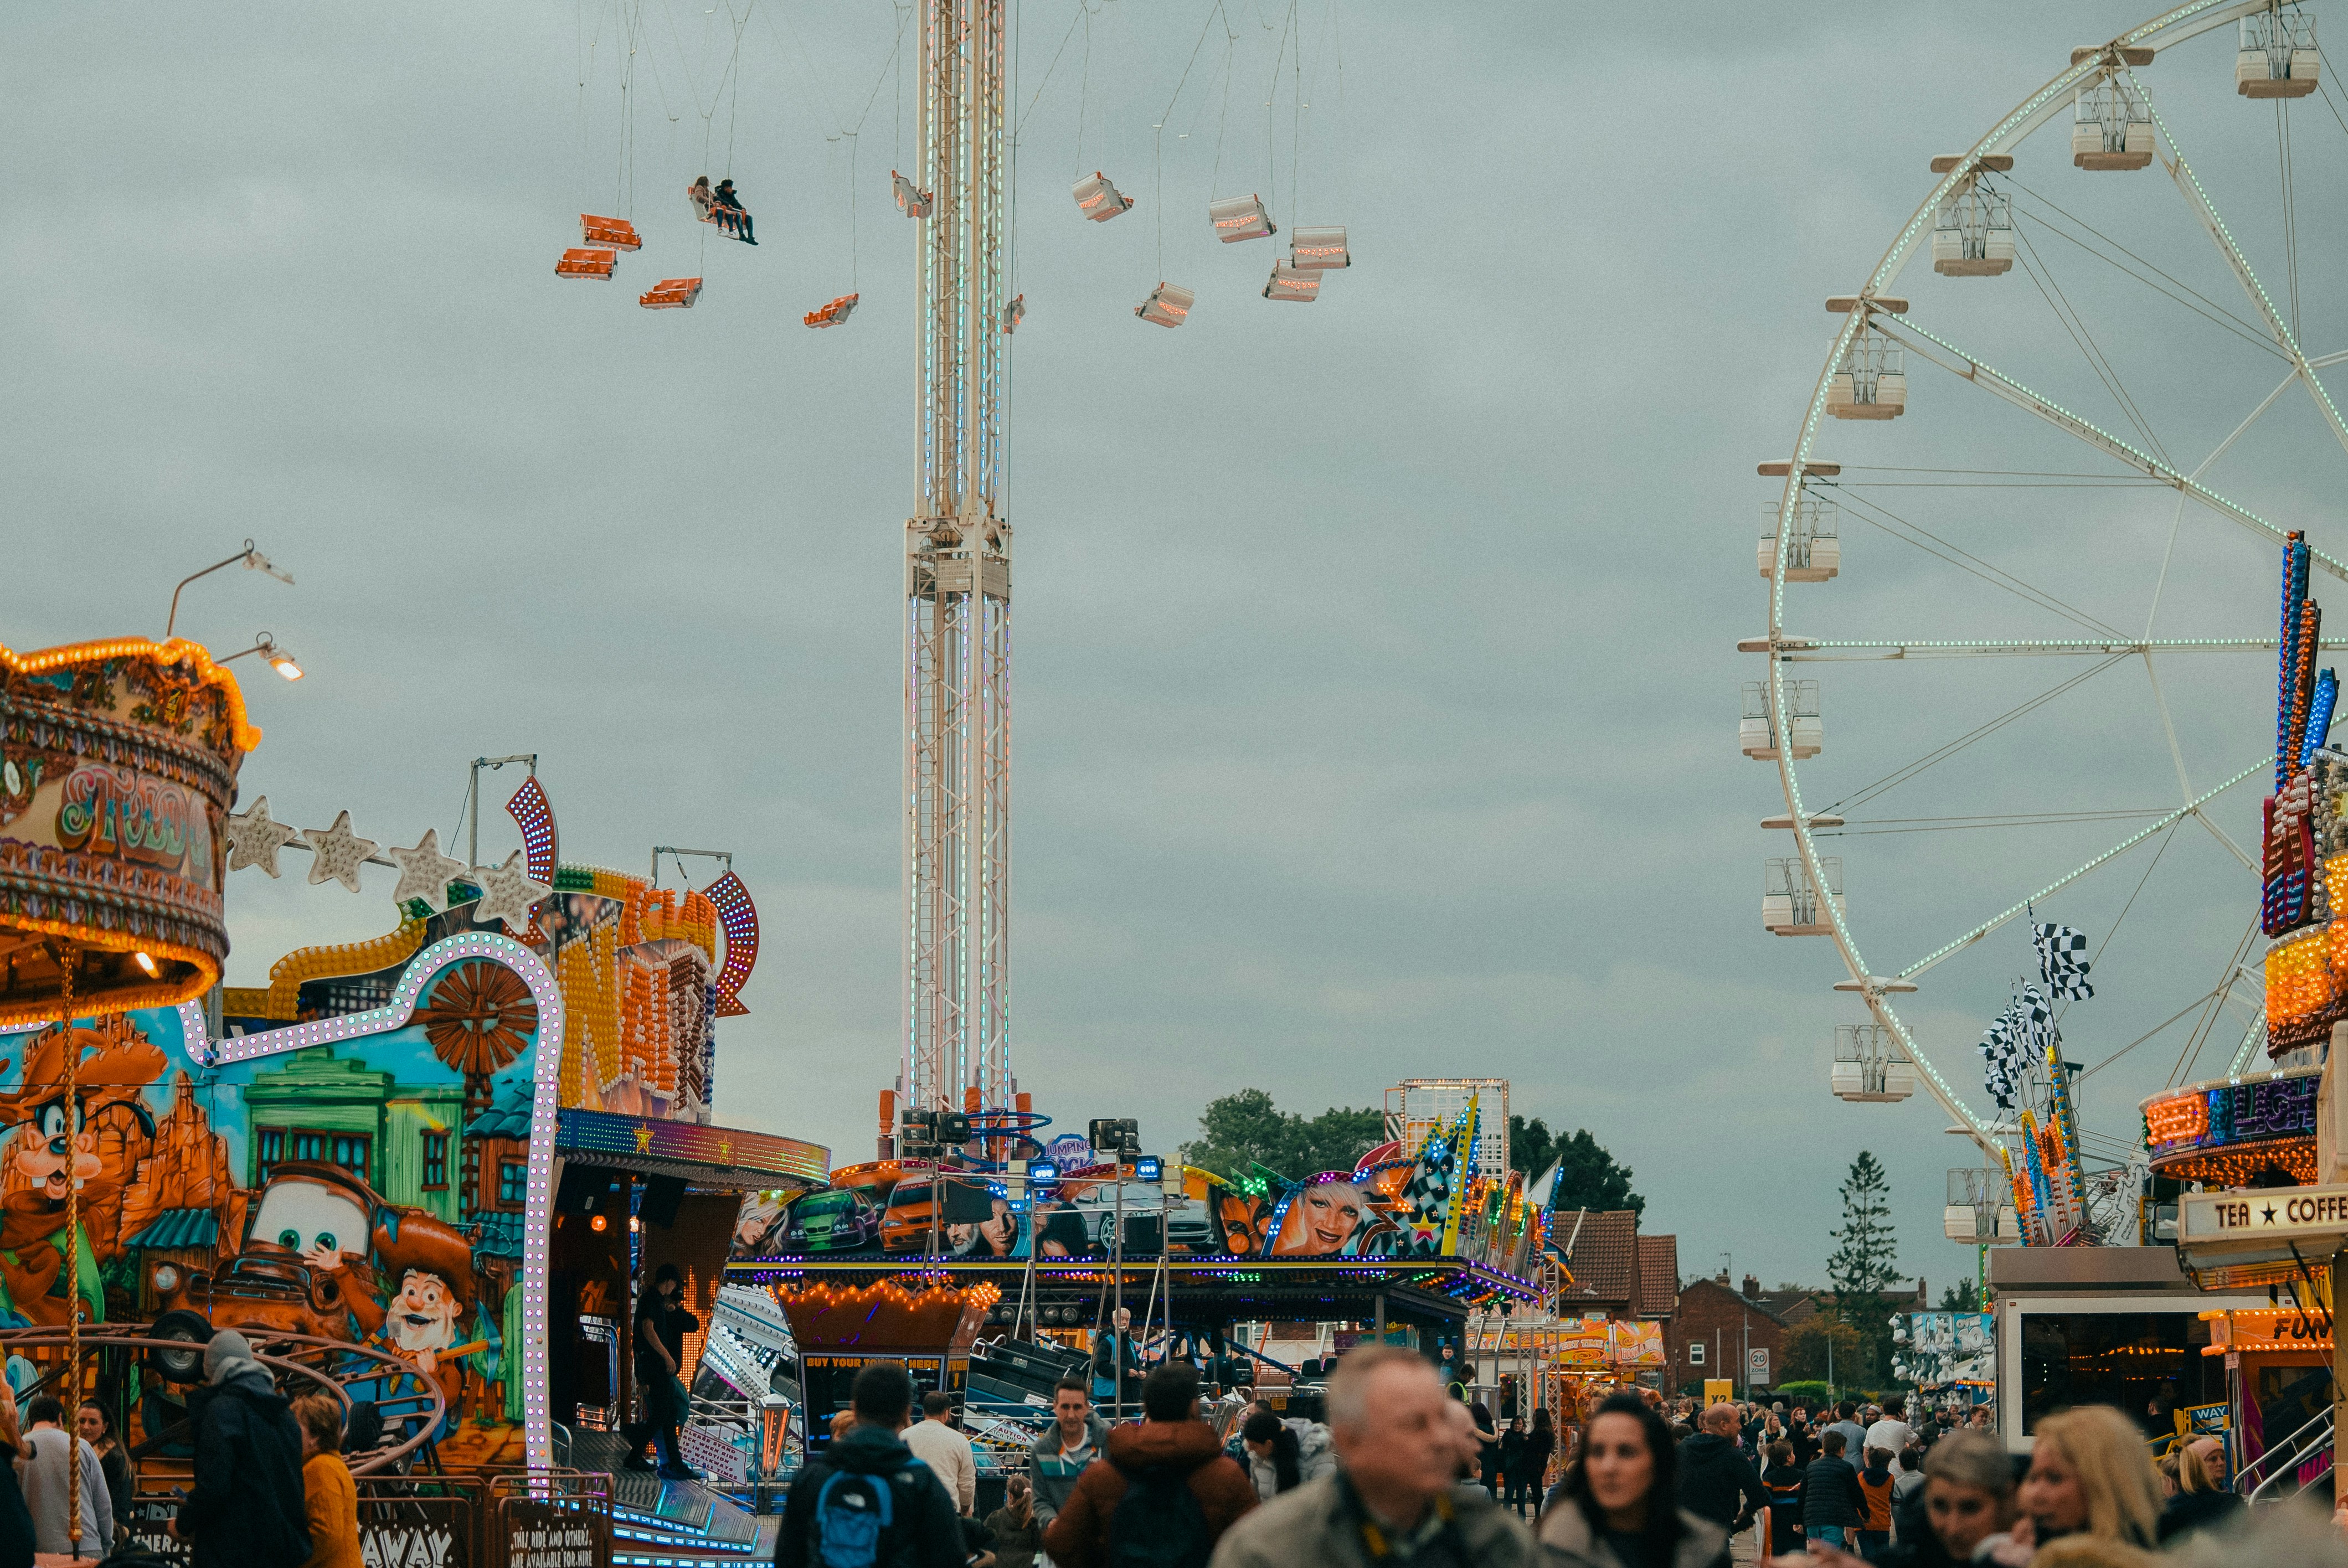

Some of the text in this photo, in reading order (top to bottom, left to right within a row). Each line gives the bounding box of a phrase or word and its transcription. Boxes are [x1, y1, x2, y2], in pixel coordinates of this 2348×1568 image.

[1044, 1138, 1091, 1158] JUMPING
[1051, 1157, 1094, 1173] ACK
[2216, 1196, 2348, 1227] TEA COFFE
[807, 1358, 828, 1367] BUY
[832, 1358, 861, 1368] YOUR
[909, 1359, 939, 1369] HERE
[1033, 1412, 1042, 1425] 2
[2196, 1406, 2226, 1419] WAY
[682, 1435, 738, 1462] ACK WHEN RIDE
[684, 1429, 736, 1454] PLEASE STAND
[694, 1452, 733, 1472] WALKWAYS
[702, 1450, 729, 1464] MOTION
[717, 1468, 738, 1480] TIMES
[361, 1528, 452, 1568] AWAY
[513, 1529, 589, 1549] THIS RIDE AND OTHERS
[511, 1550, 592, 1568] ARE AVAILABLE FOR HIRE
